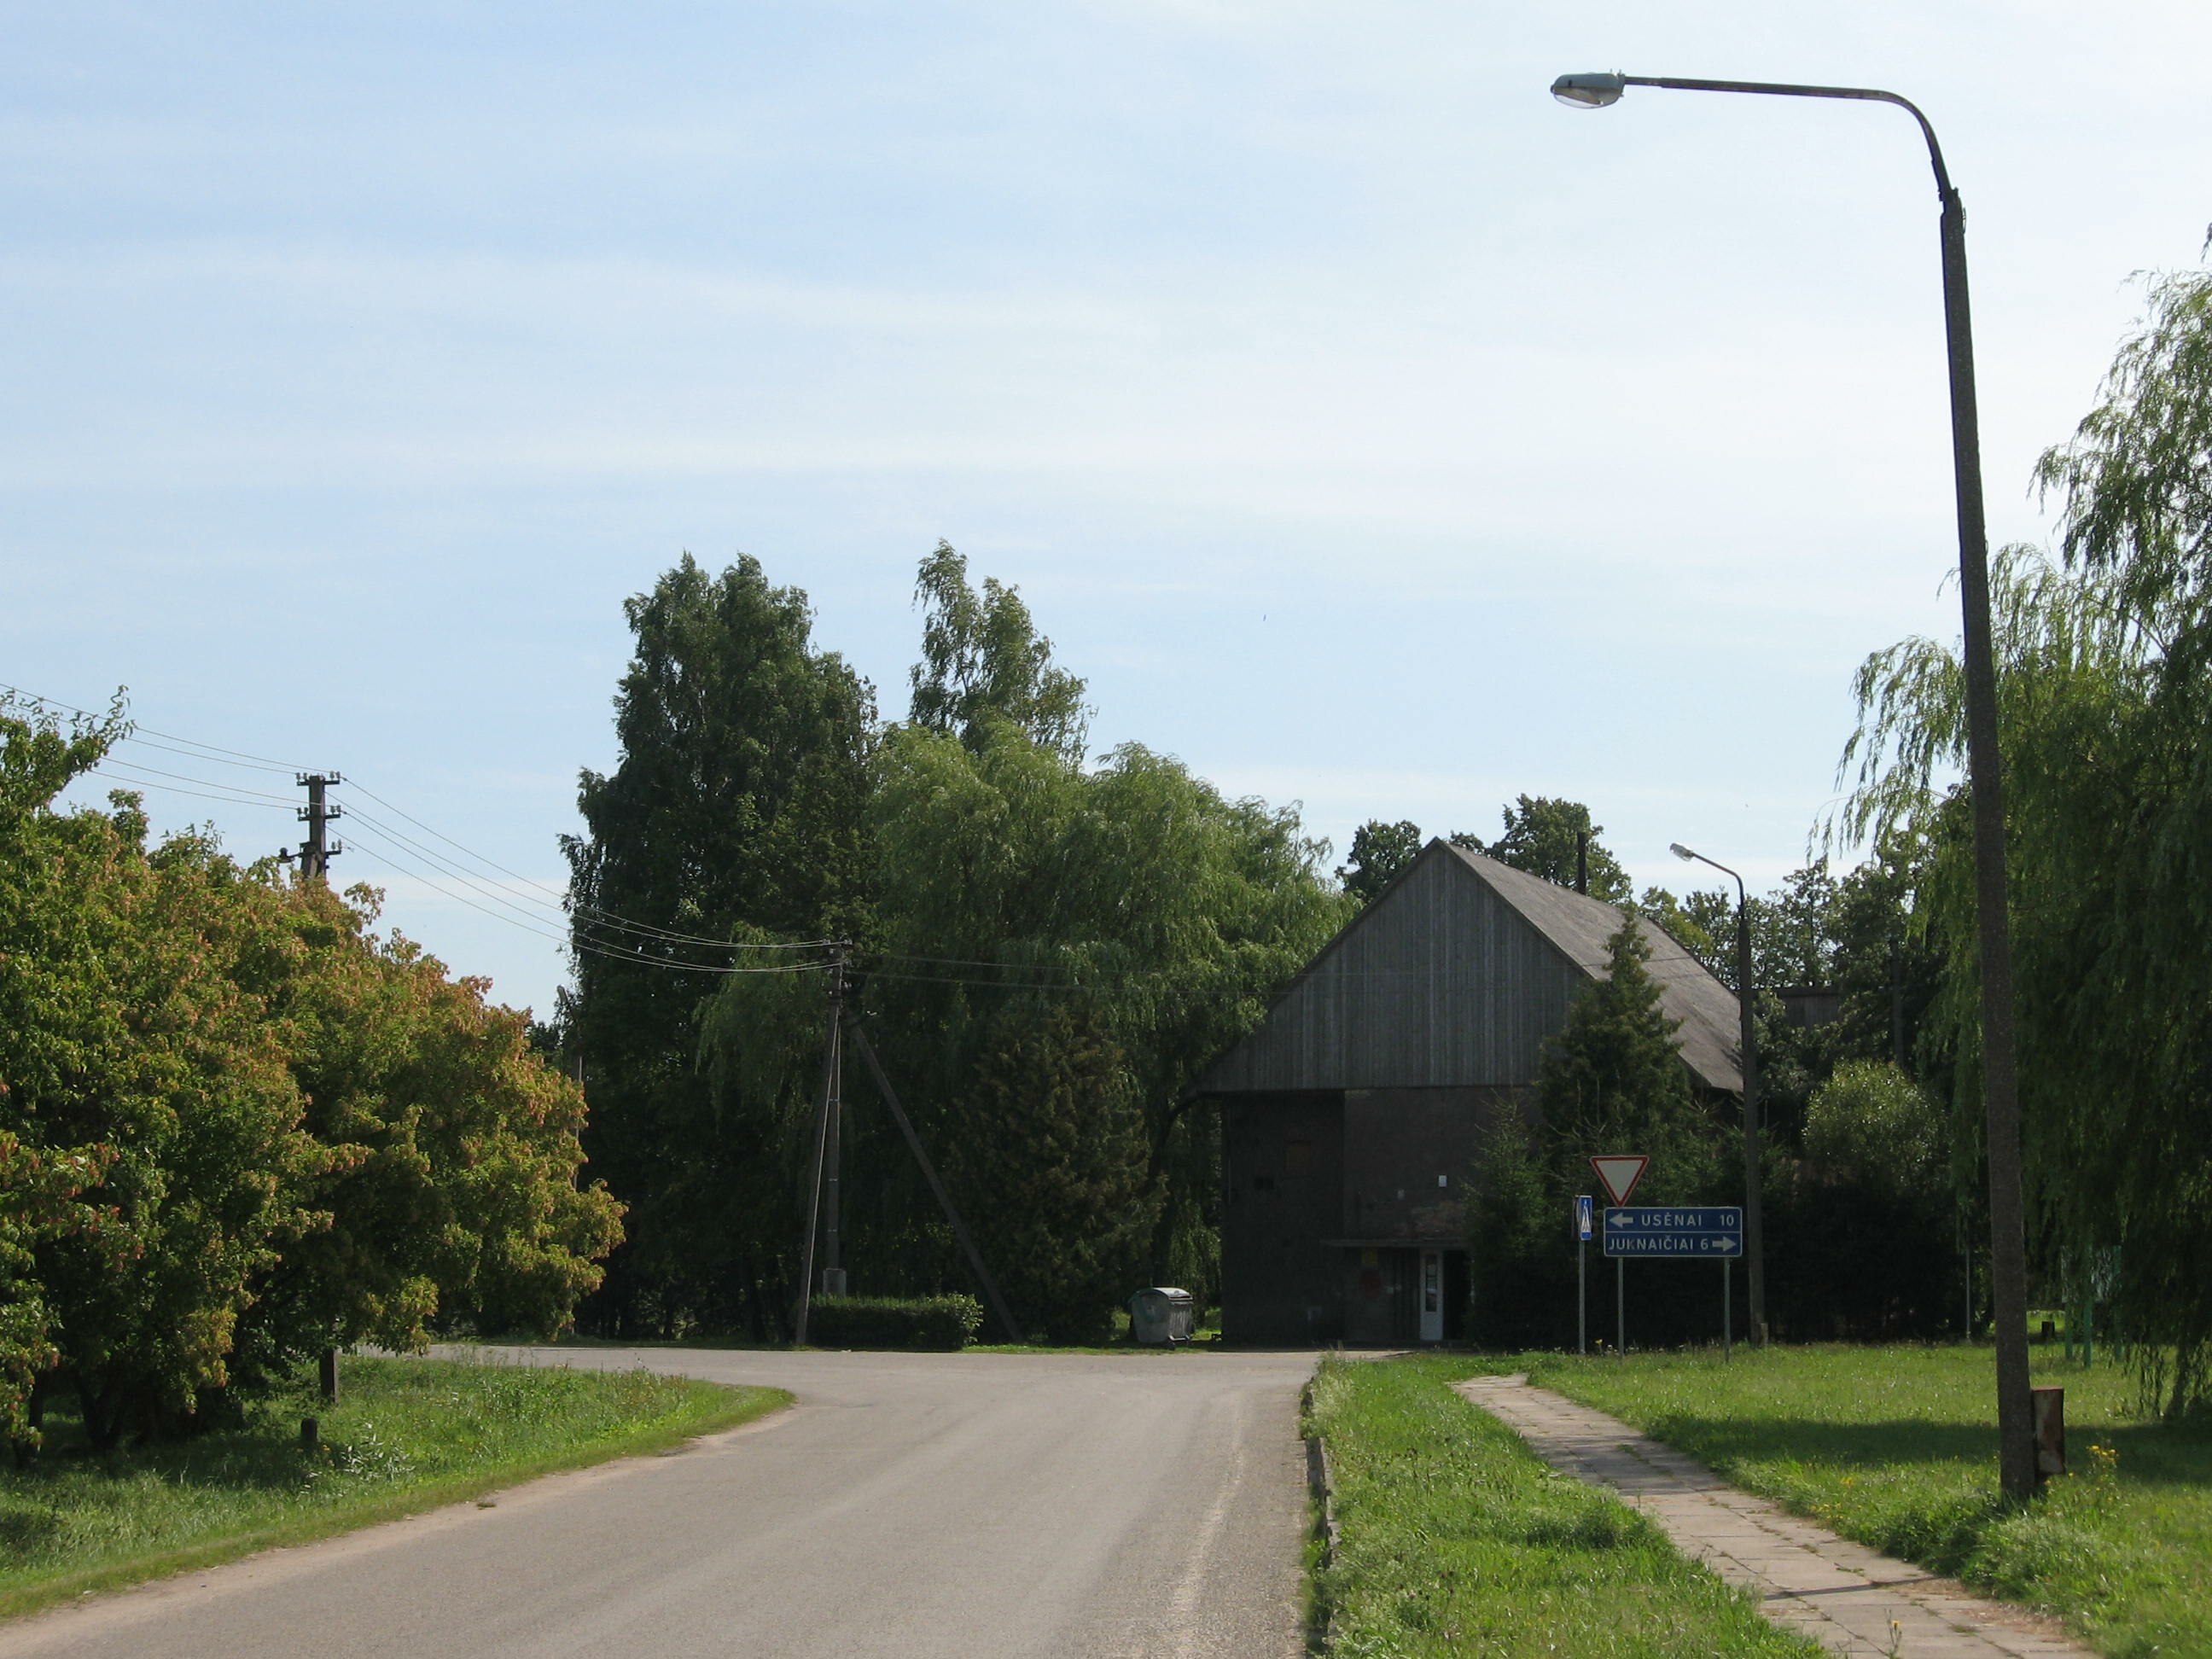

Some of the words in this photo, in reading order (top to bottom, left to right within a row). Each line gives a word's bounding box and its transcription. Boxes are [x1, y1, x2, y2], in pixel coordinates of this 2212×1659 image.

[1641, 1212, 1703, 1226] USĖNAI
[1720, 1214, 1734, 1226] 10
[1609, 1235, 1693, 1250] JUKNAIČIAI
[1700, 1238, 1708, 1250] 6
